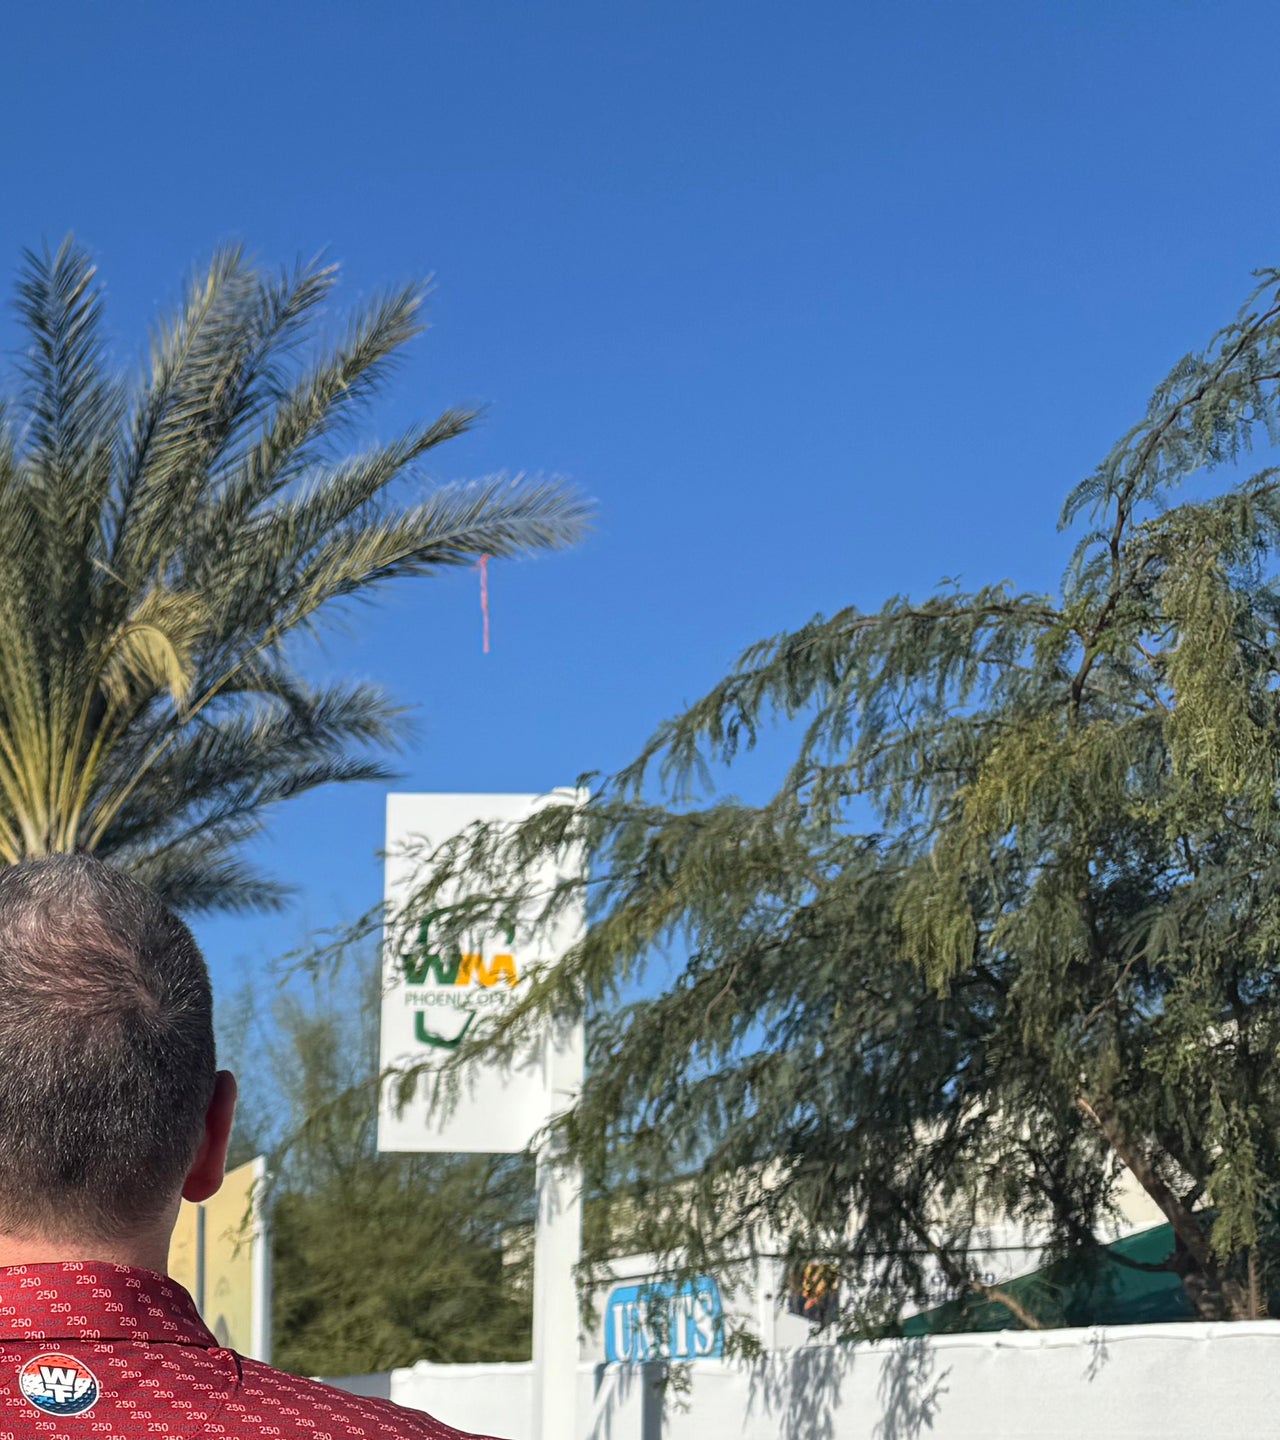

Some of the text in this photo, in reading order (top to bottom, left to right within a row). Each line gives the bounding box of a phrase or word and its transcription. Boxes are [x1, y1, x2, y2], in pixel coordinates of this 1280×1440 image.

[402, 953, 518, 987] WM
[75, 1274, 97, 1285] 250
[10, 1317, 32, 1328] 250
[119, 1316, 138, 1327] 250
